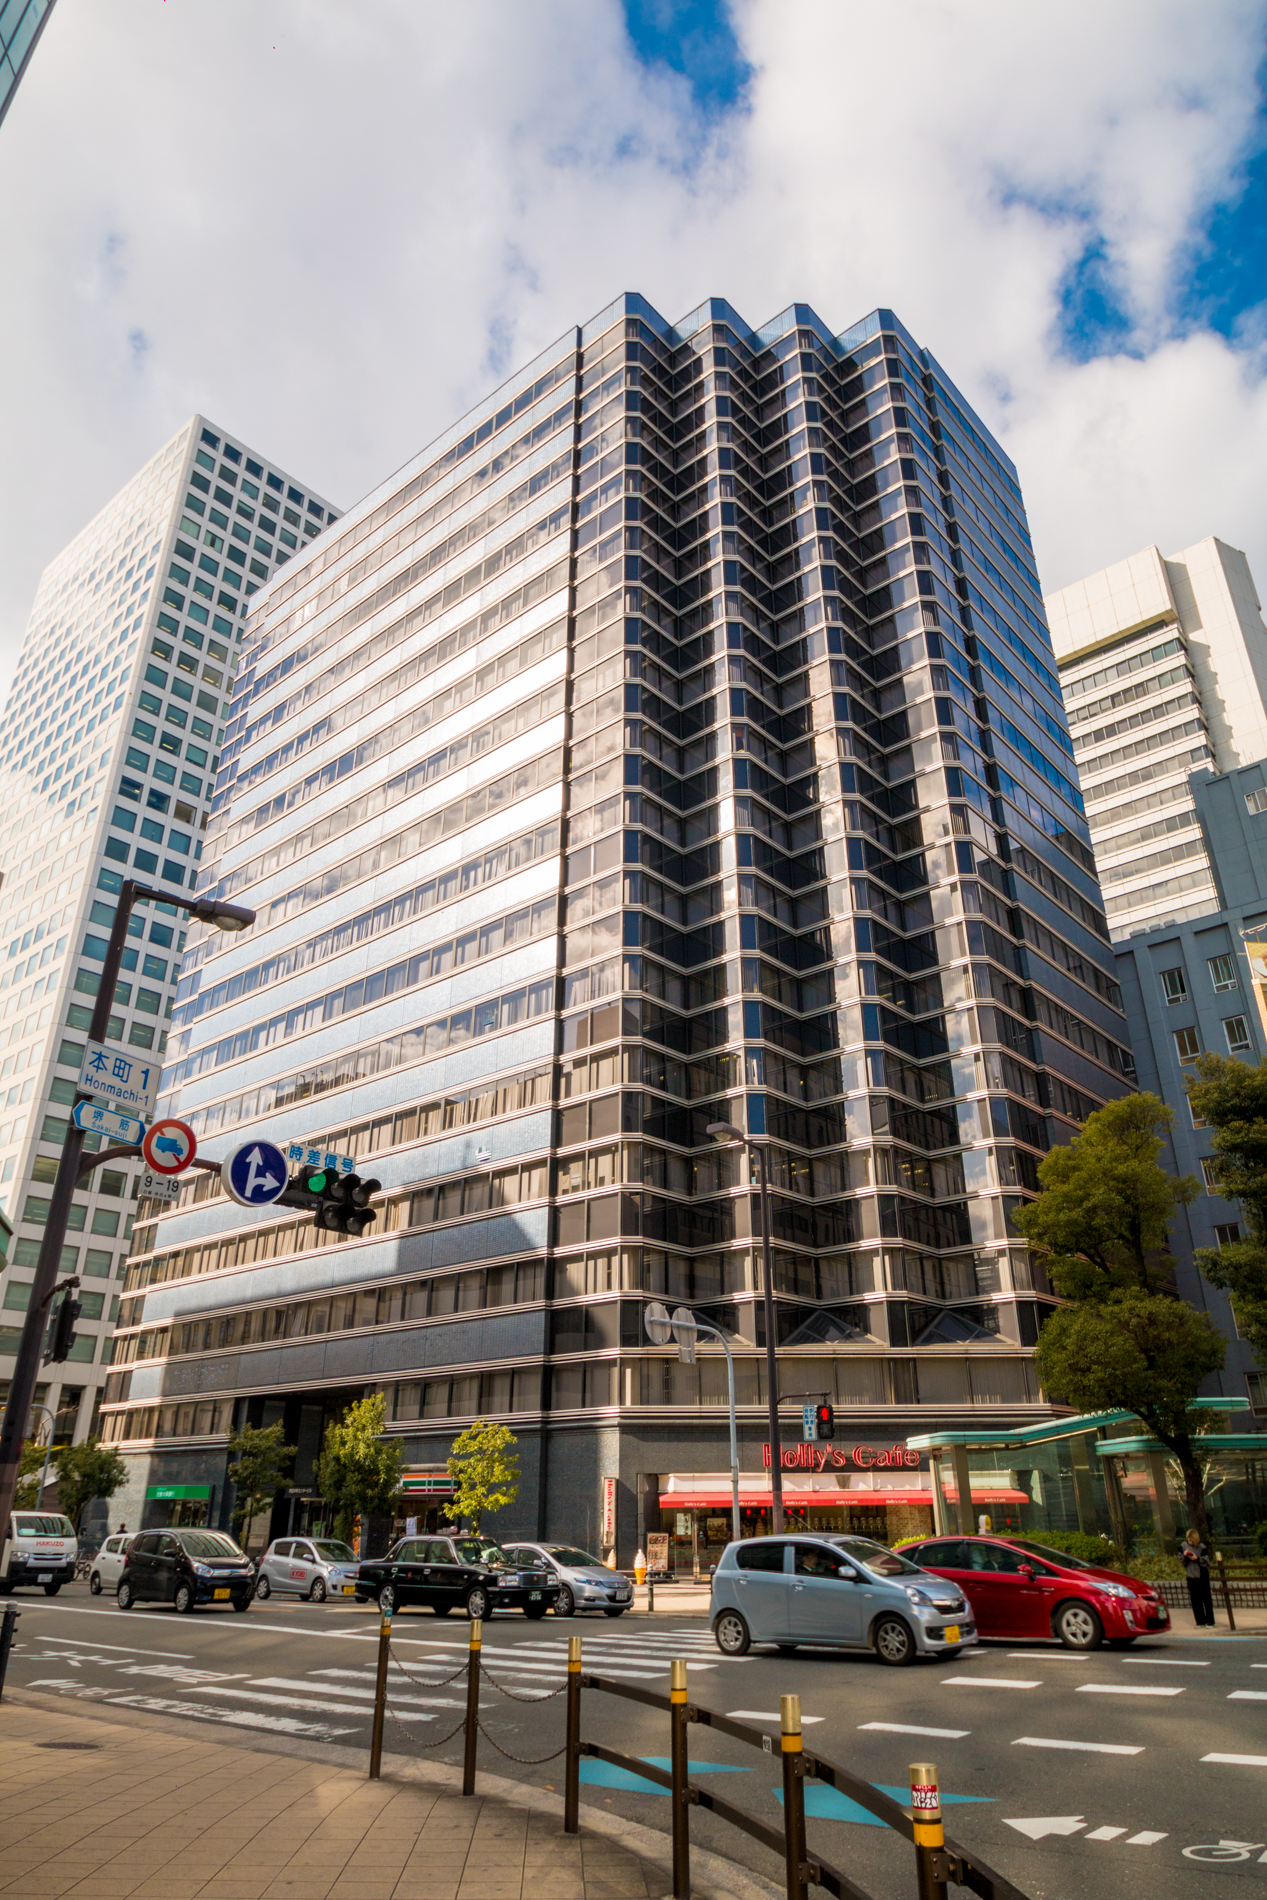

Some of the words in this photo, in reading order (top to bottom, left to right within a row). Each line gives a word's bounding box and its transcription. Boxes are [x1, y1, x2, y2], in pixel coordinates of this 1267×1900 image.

[88, 1050, 133, 1083] 本町
[141, 1067, 150, 1091] 1
[84, 1073, 149, 1107] Honmachi-1
[91, 1121, 128, 1139] Sakai-suji
[92, 1109, 130, 1132] 堺筋
[288, 1144, 354, 1173] 時差信号
[763, 1443, 846, 1472] Holly's
